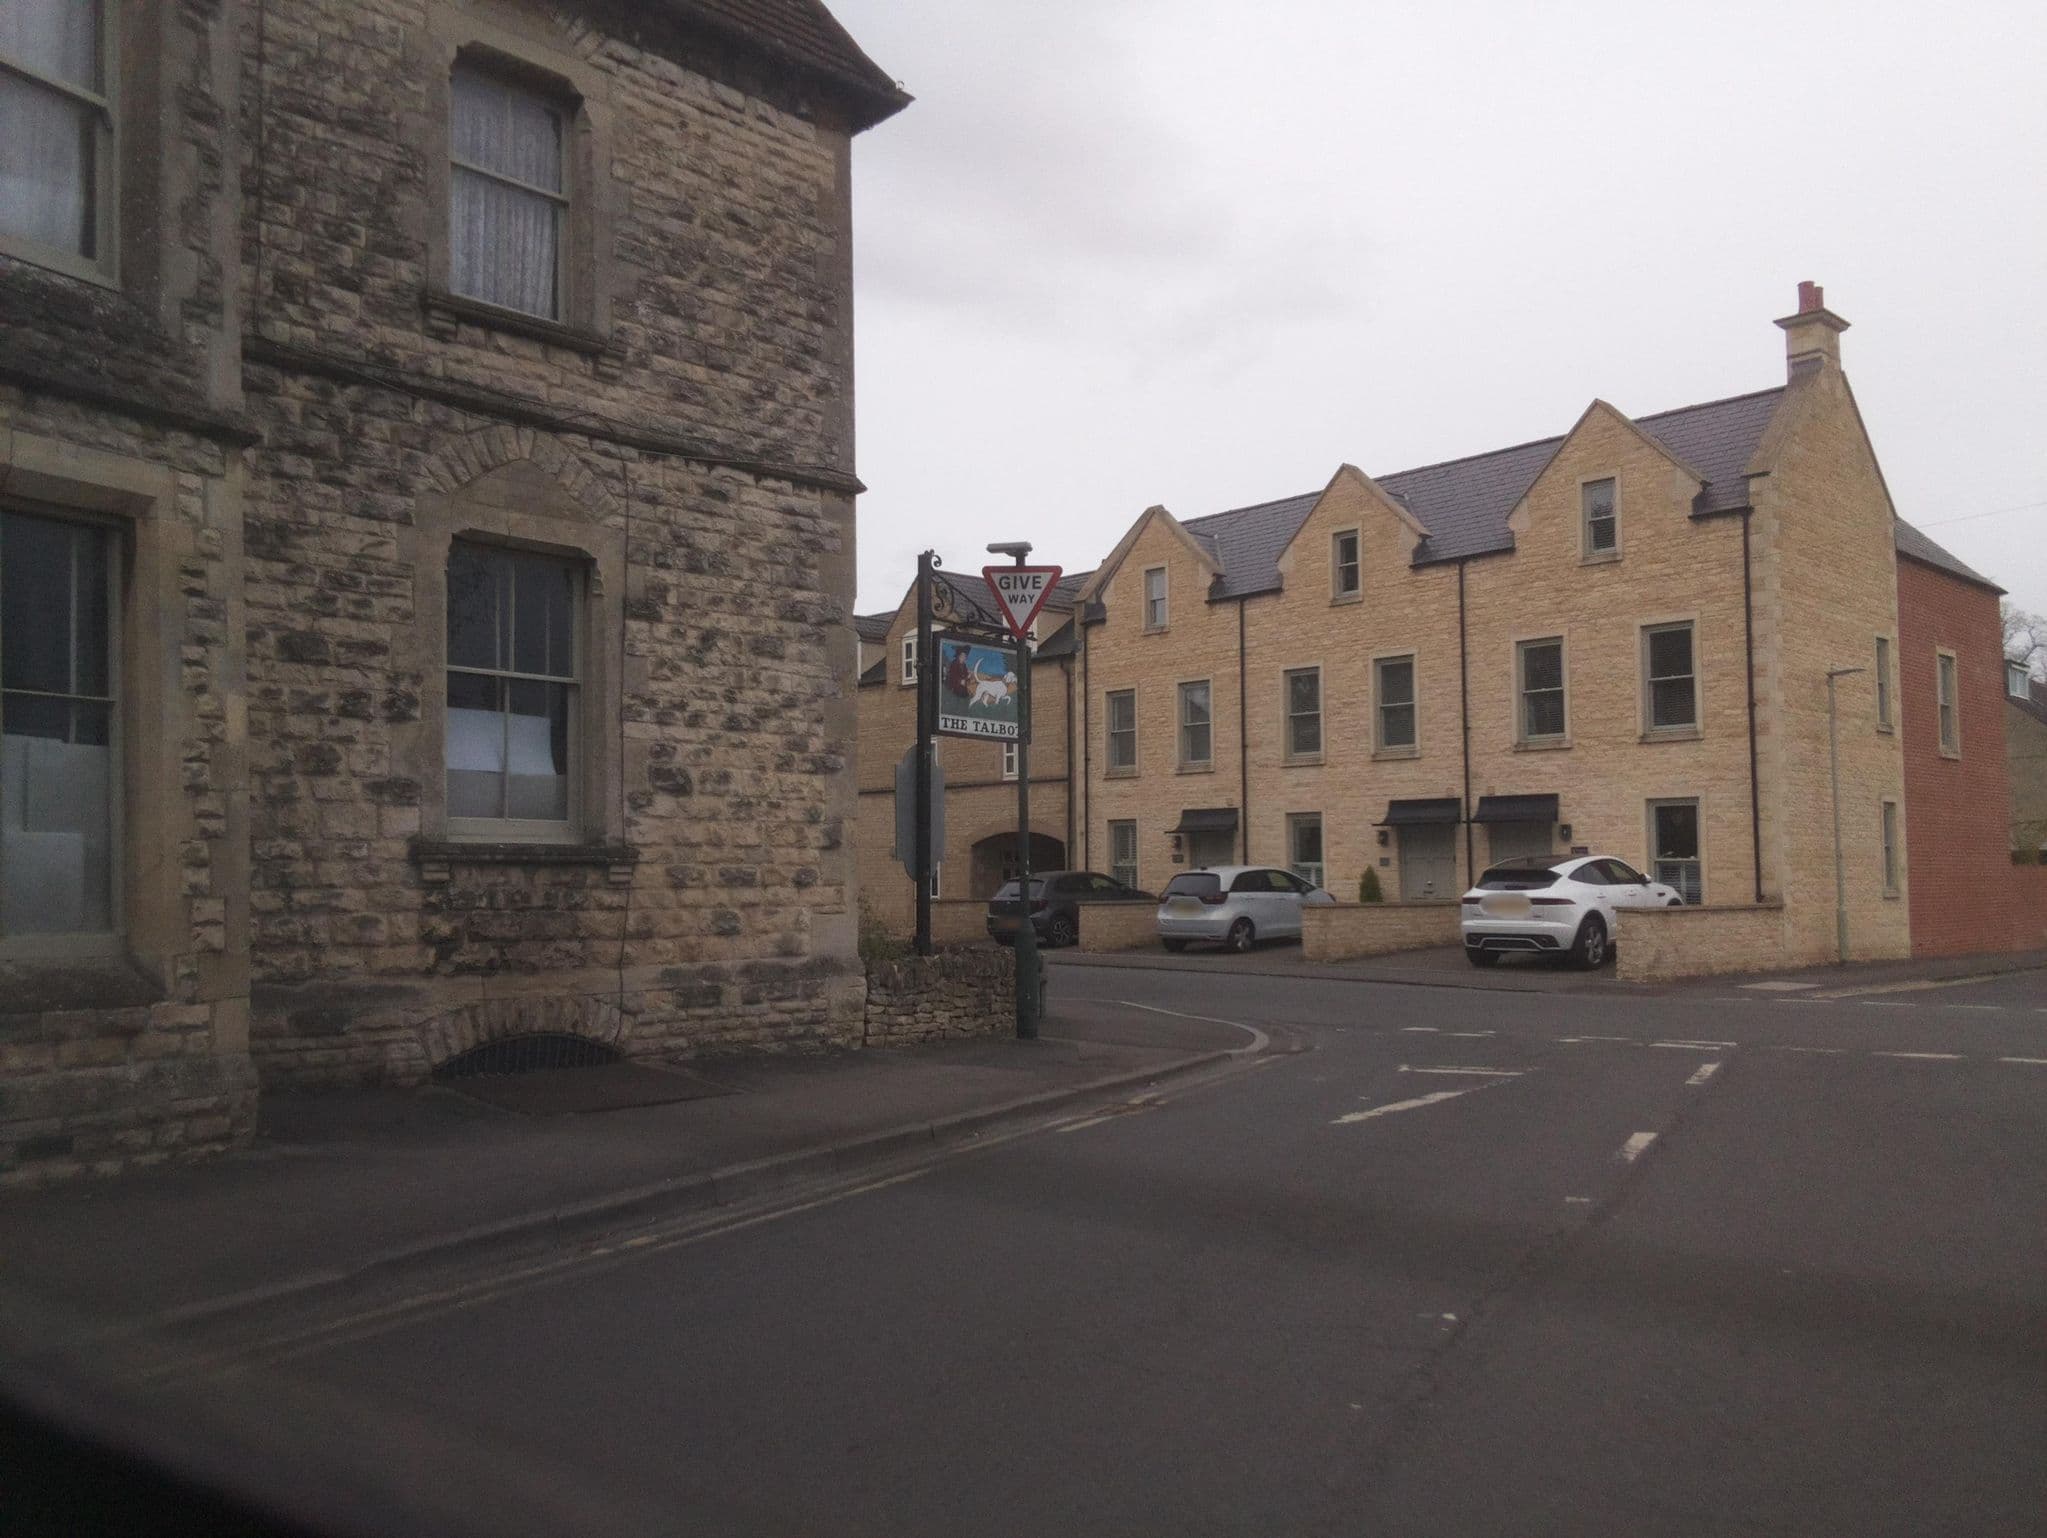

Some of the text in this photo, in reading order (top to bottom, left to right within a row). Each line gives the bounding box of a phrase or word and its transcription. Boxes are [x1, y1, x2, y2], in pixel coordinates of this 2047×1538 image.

[999, 575, 1042, 590] GIVE
[1008, 594, 1035, 604] WAY
[941, 717, 967, 730] THE
